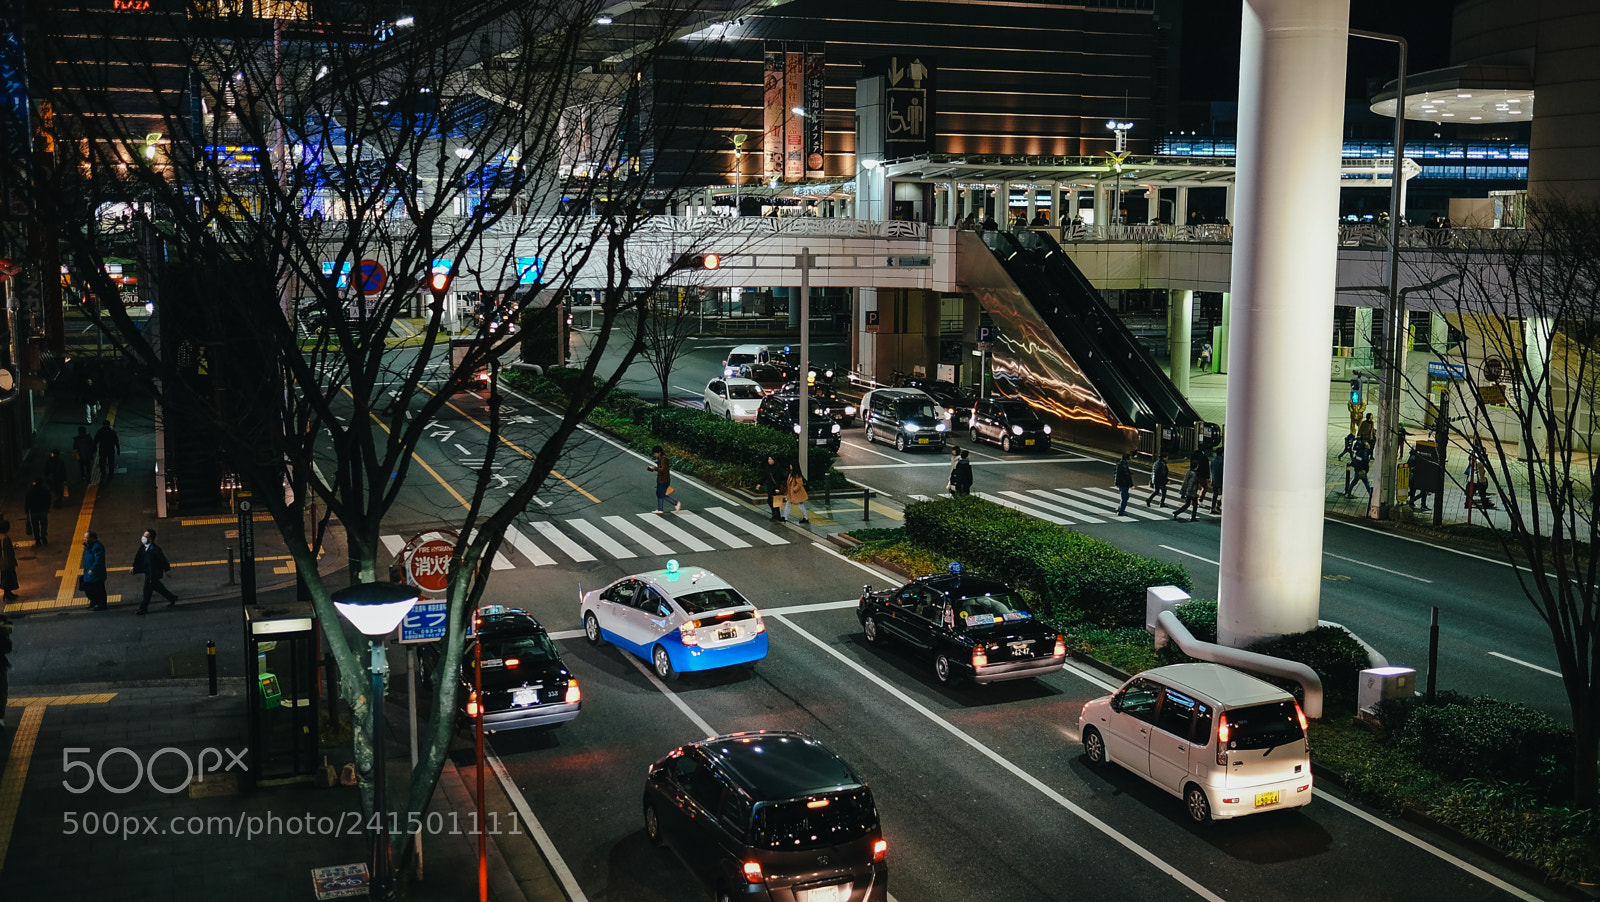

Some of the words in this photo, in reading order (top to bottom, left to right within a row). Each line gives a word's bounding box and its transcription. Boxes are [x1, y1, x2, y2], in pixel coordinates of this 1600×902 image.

[113, 0, 150, 10] PLAZA
[812, 79, 821, 153] 北海道グルメフェア
[869, 313, 878, 324] P
[980, 327, 990, 341] P
